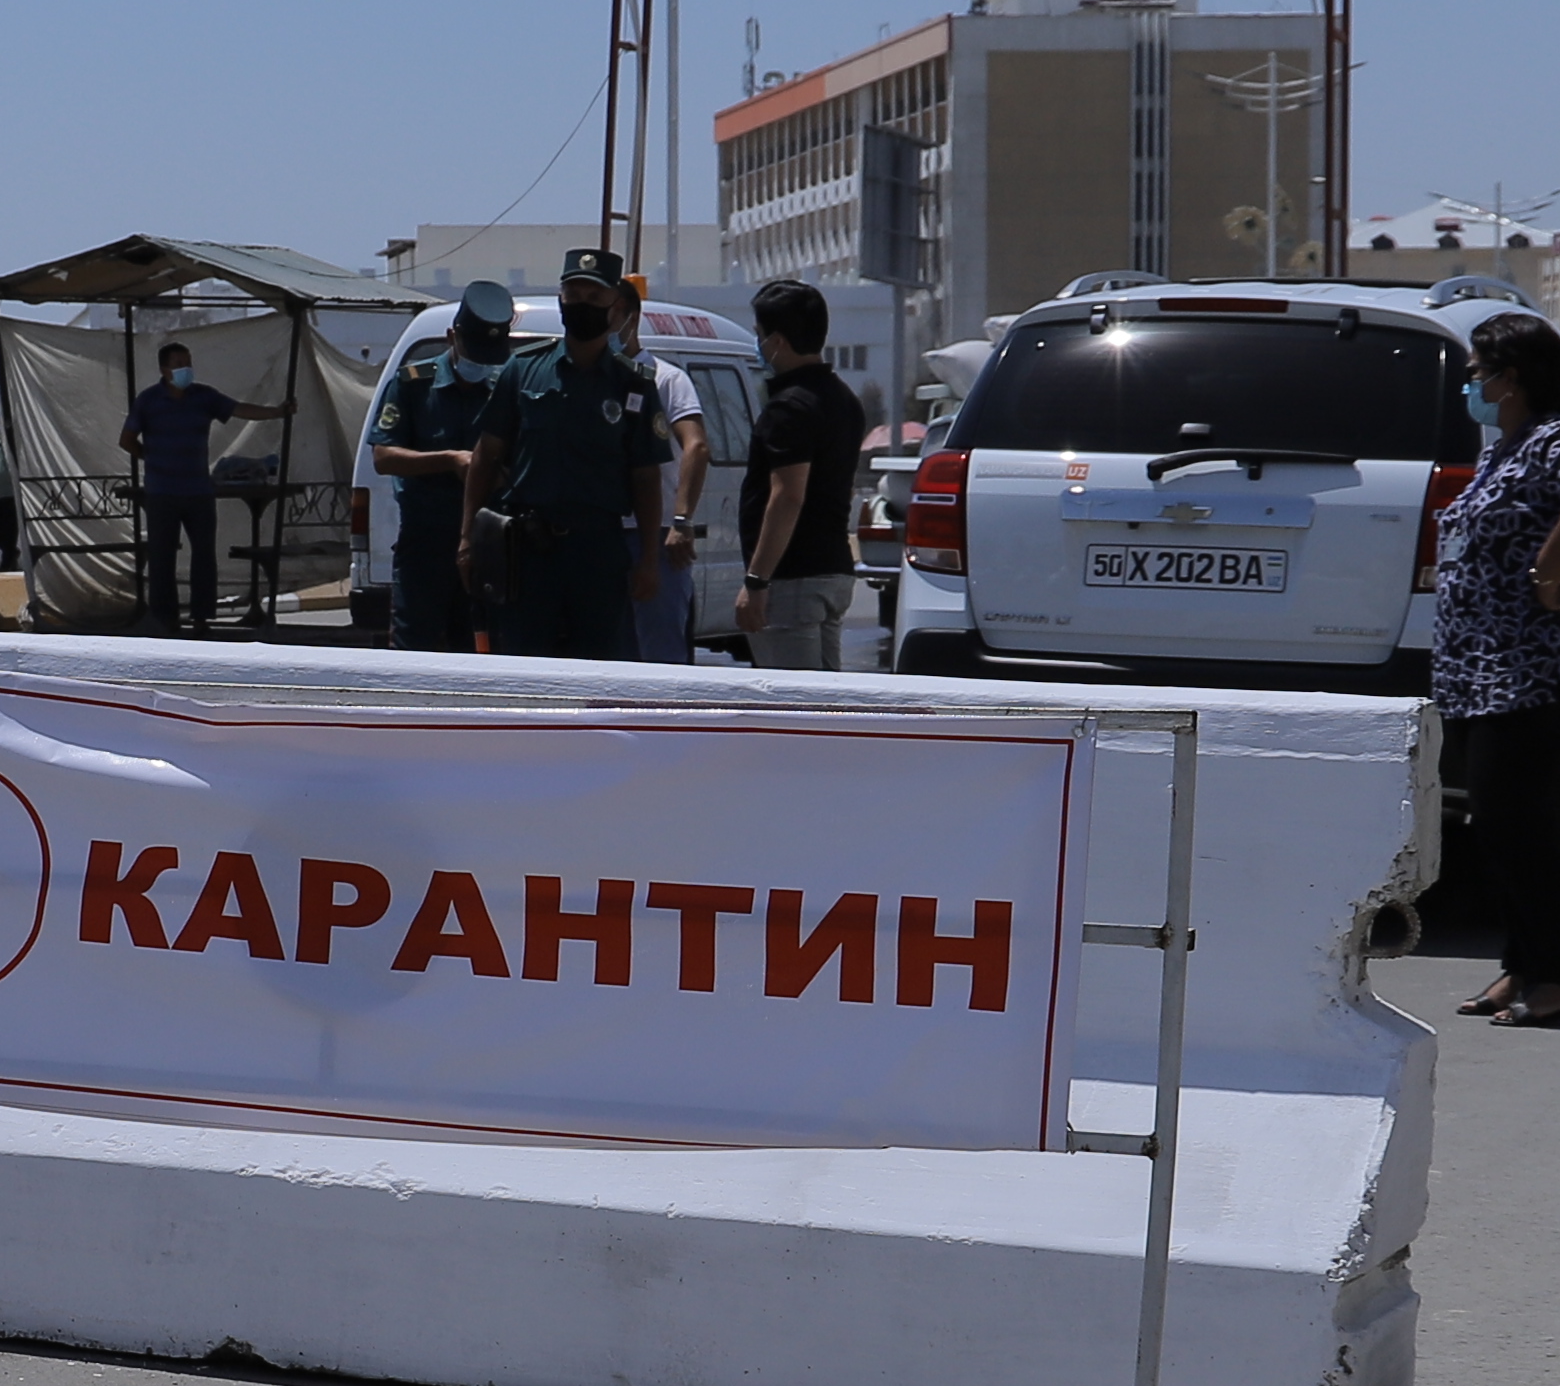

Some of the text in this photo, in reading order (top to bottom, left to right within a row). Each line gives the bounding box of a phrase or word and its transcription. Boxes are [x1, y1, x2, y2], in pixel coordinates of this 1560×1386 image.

[1068, 466, 1087, 477] UZ
[1094, 554, 1123, 577] 50
[79, 840, 1013, 1013] КАРАНТИН
